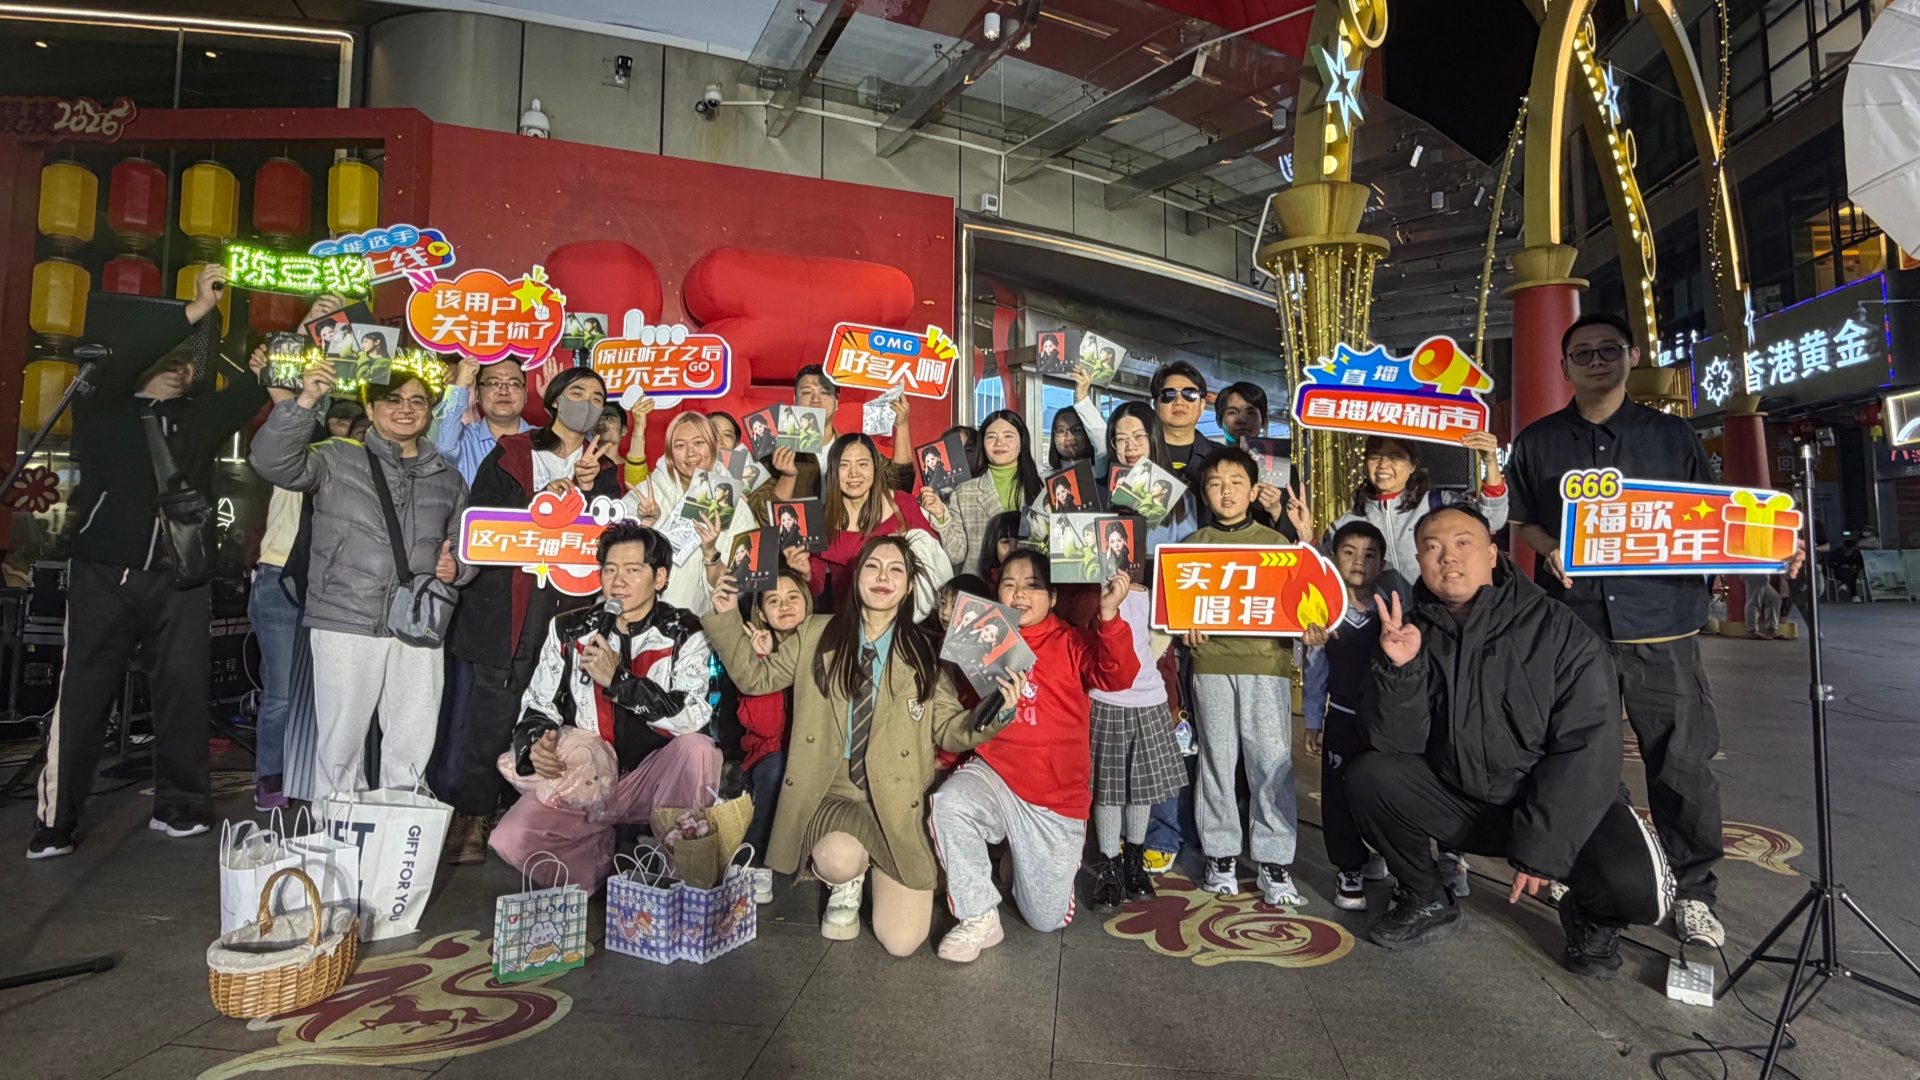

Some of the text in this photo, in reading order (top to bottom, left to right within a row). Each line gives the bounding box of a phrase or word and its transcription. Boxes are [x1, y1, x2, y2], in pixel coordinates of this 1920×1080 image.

[435, 289, 517, 315] 该用户
[431, 314, 554, 348] 关注你了
[873, 334, 913, 352] OMG
[597, 345, 725, 365] 保证听了之后
[688, 361, 710, 372] GO
[838, 348, 947, 389] 好多人啊
[1747, 318, 1870, 394] 香港黄金
[599, 366, 680, 388] 出不去
[1341, 365, 1400, 386] 直播
[1306, 397, 1481, 431] 直播焕新声
[1565, 472, 1617, 499] 666
[1582, 500, 1674, 534] 福歌
[1582, 529, 1720, 565] 唱马年
[1175, 561, 1257, 590] 实力
[1192, 595, 1276, 625] 唱将
[388, 824, 422, 922] GIFT FOR YOU
